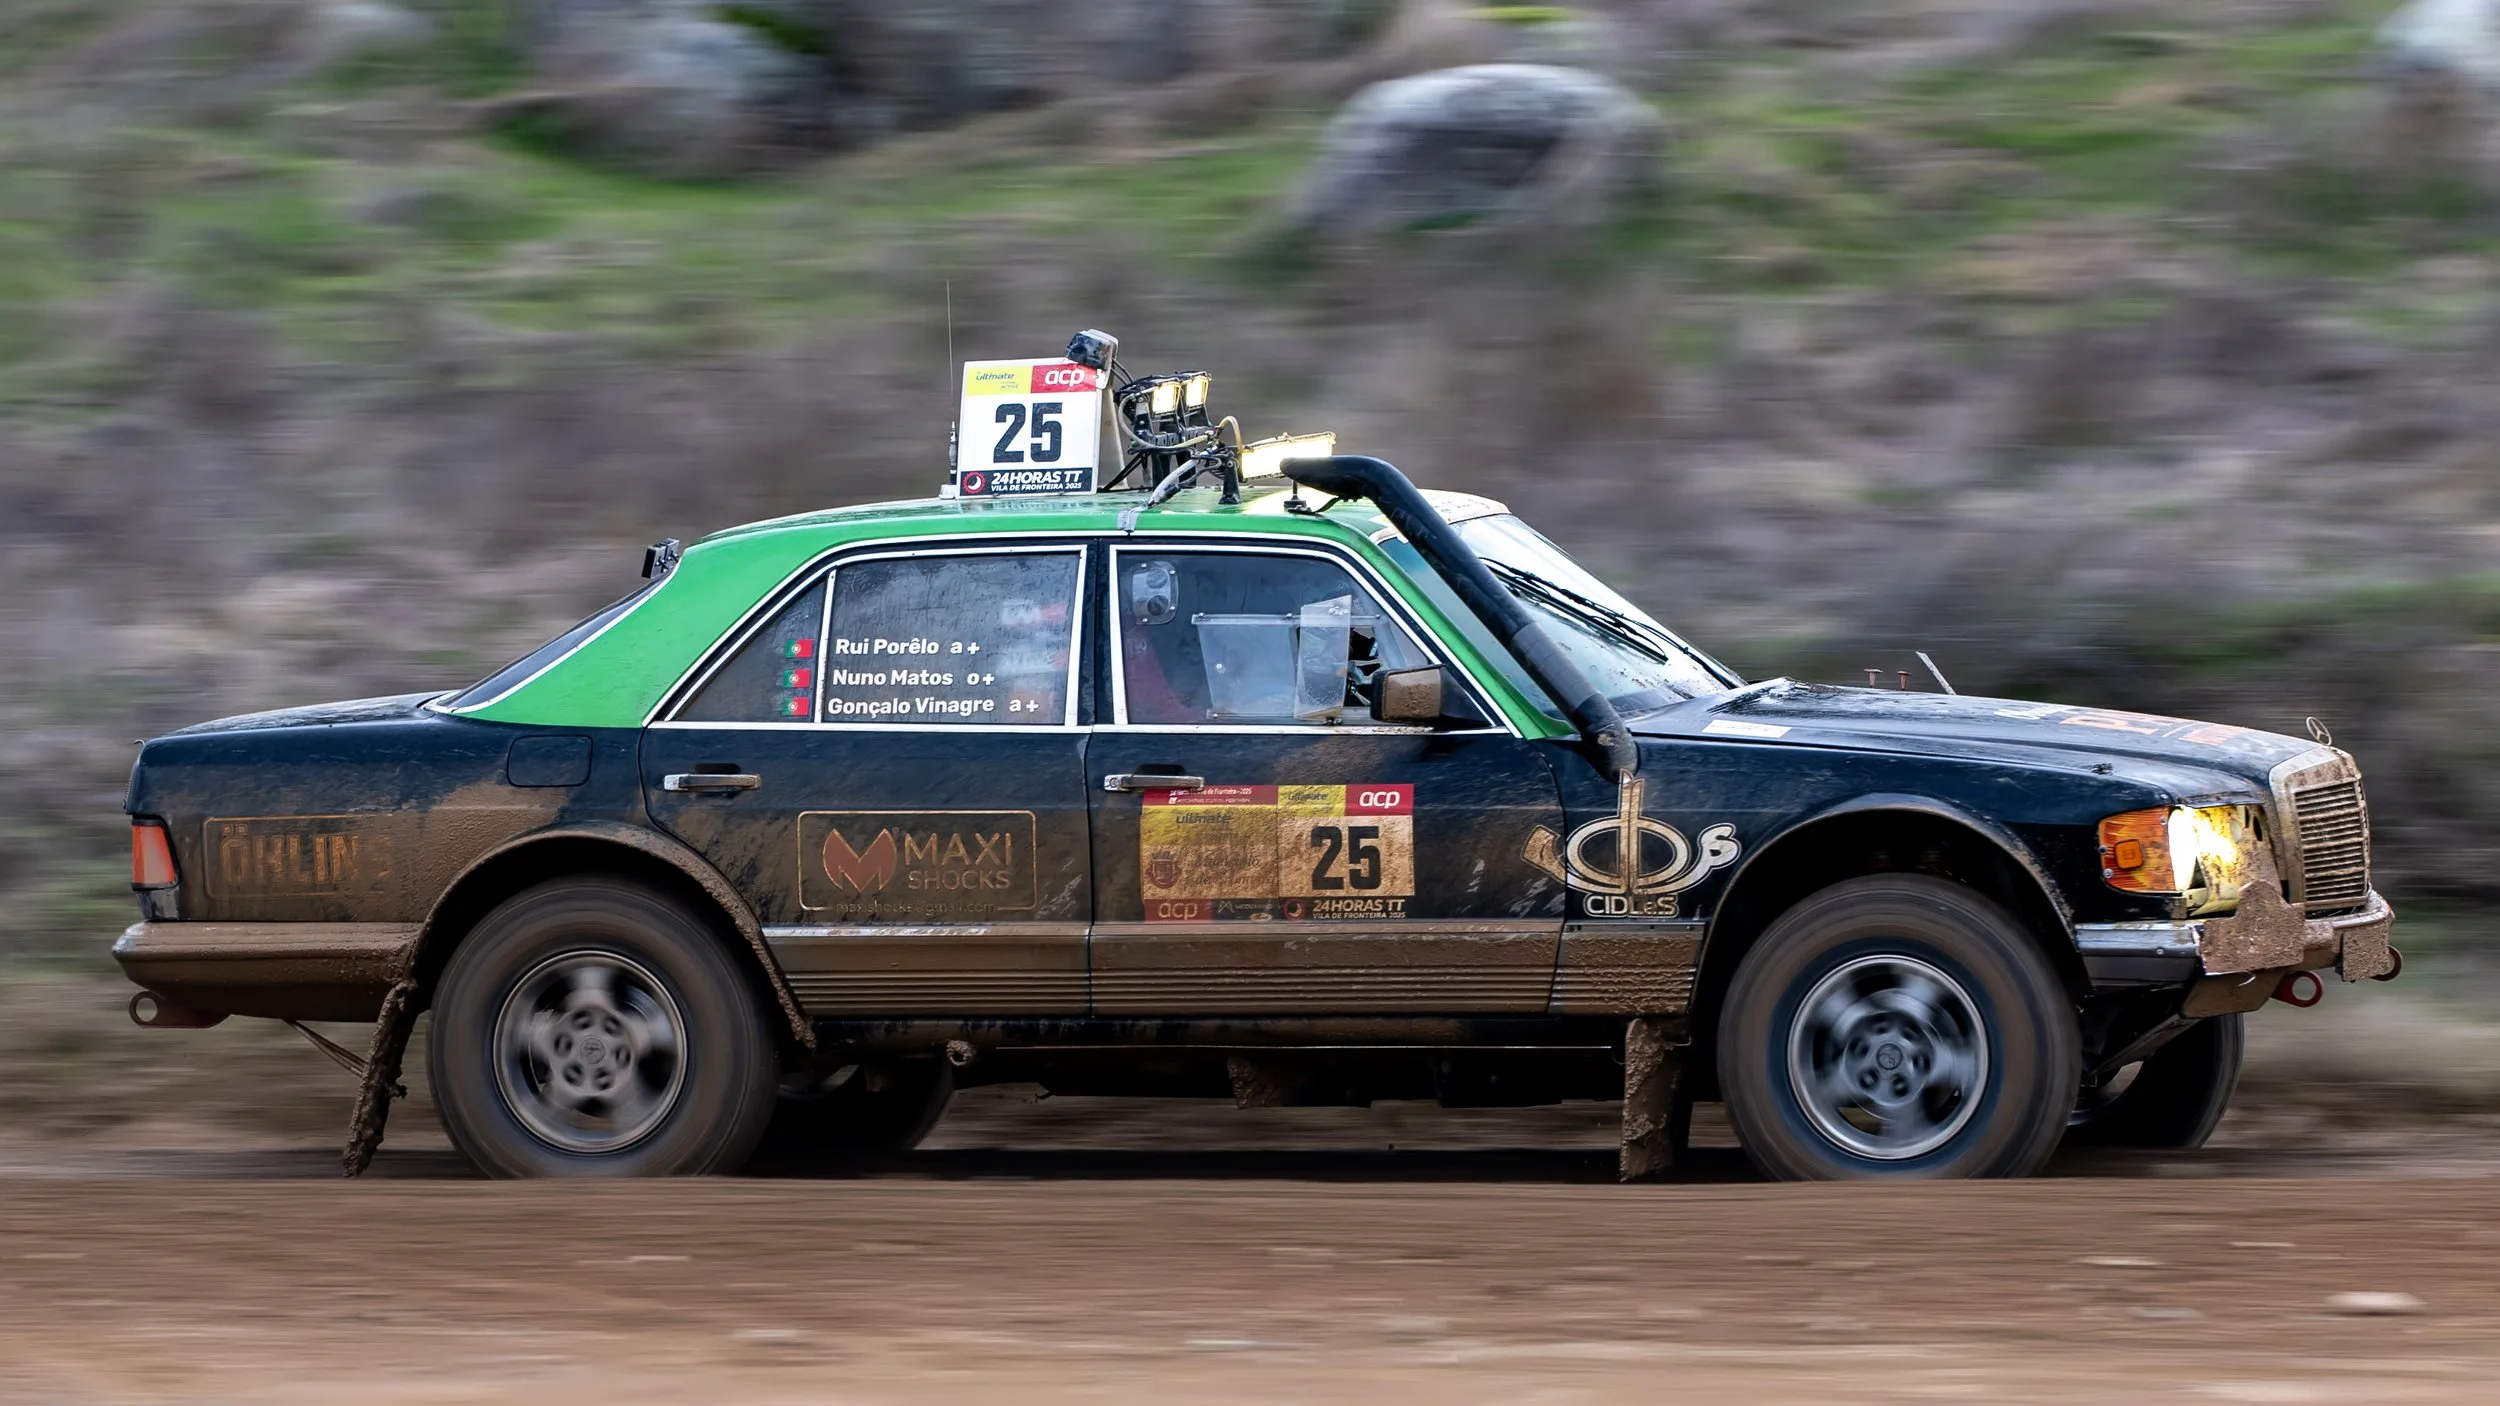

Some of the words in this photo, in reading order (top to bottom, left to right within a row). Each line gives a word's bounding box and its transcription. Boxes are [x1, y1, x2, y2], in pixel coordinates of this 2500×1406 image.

[1045, 369, 1085, 387] acp
[993, 402, 1063, 463] 25
[1064, 470, 1083, 483] TT
[991, 484, 1008, 492] VILA
[1021, 483, 1064, 491] FRONTEIRA
[1065, 482, 1082, 490] 2025
[835, 637, 869, 655] Rui
[873, 637, 940, 655] Porêlo
[833, 669, 887, 685] Nuno
[890, 669, 954, 686] Matos
[828, 697, 911, 718] Gonçalo
[915, 697, 995, 717] Vinagre
[1359, 790, 1400, 809] acp
[904, 832, 1013, 866] MAXI
[1311, 826, 1382, 890] 25
[907, 870, 1012, 891] SHOCKS
[1158, 902, 1199, 920] acp
[1385, 899, 1405, 911] TT
[1343, 911, 1387, 919] FRONTEIRA
